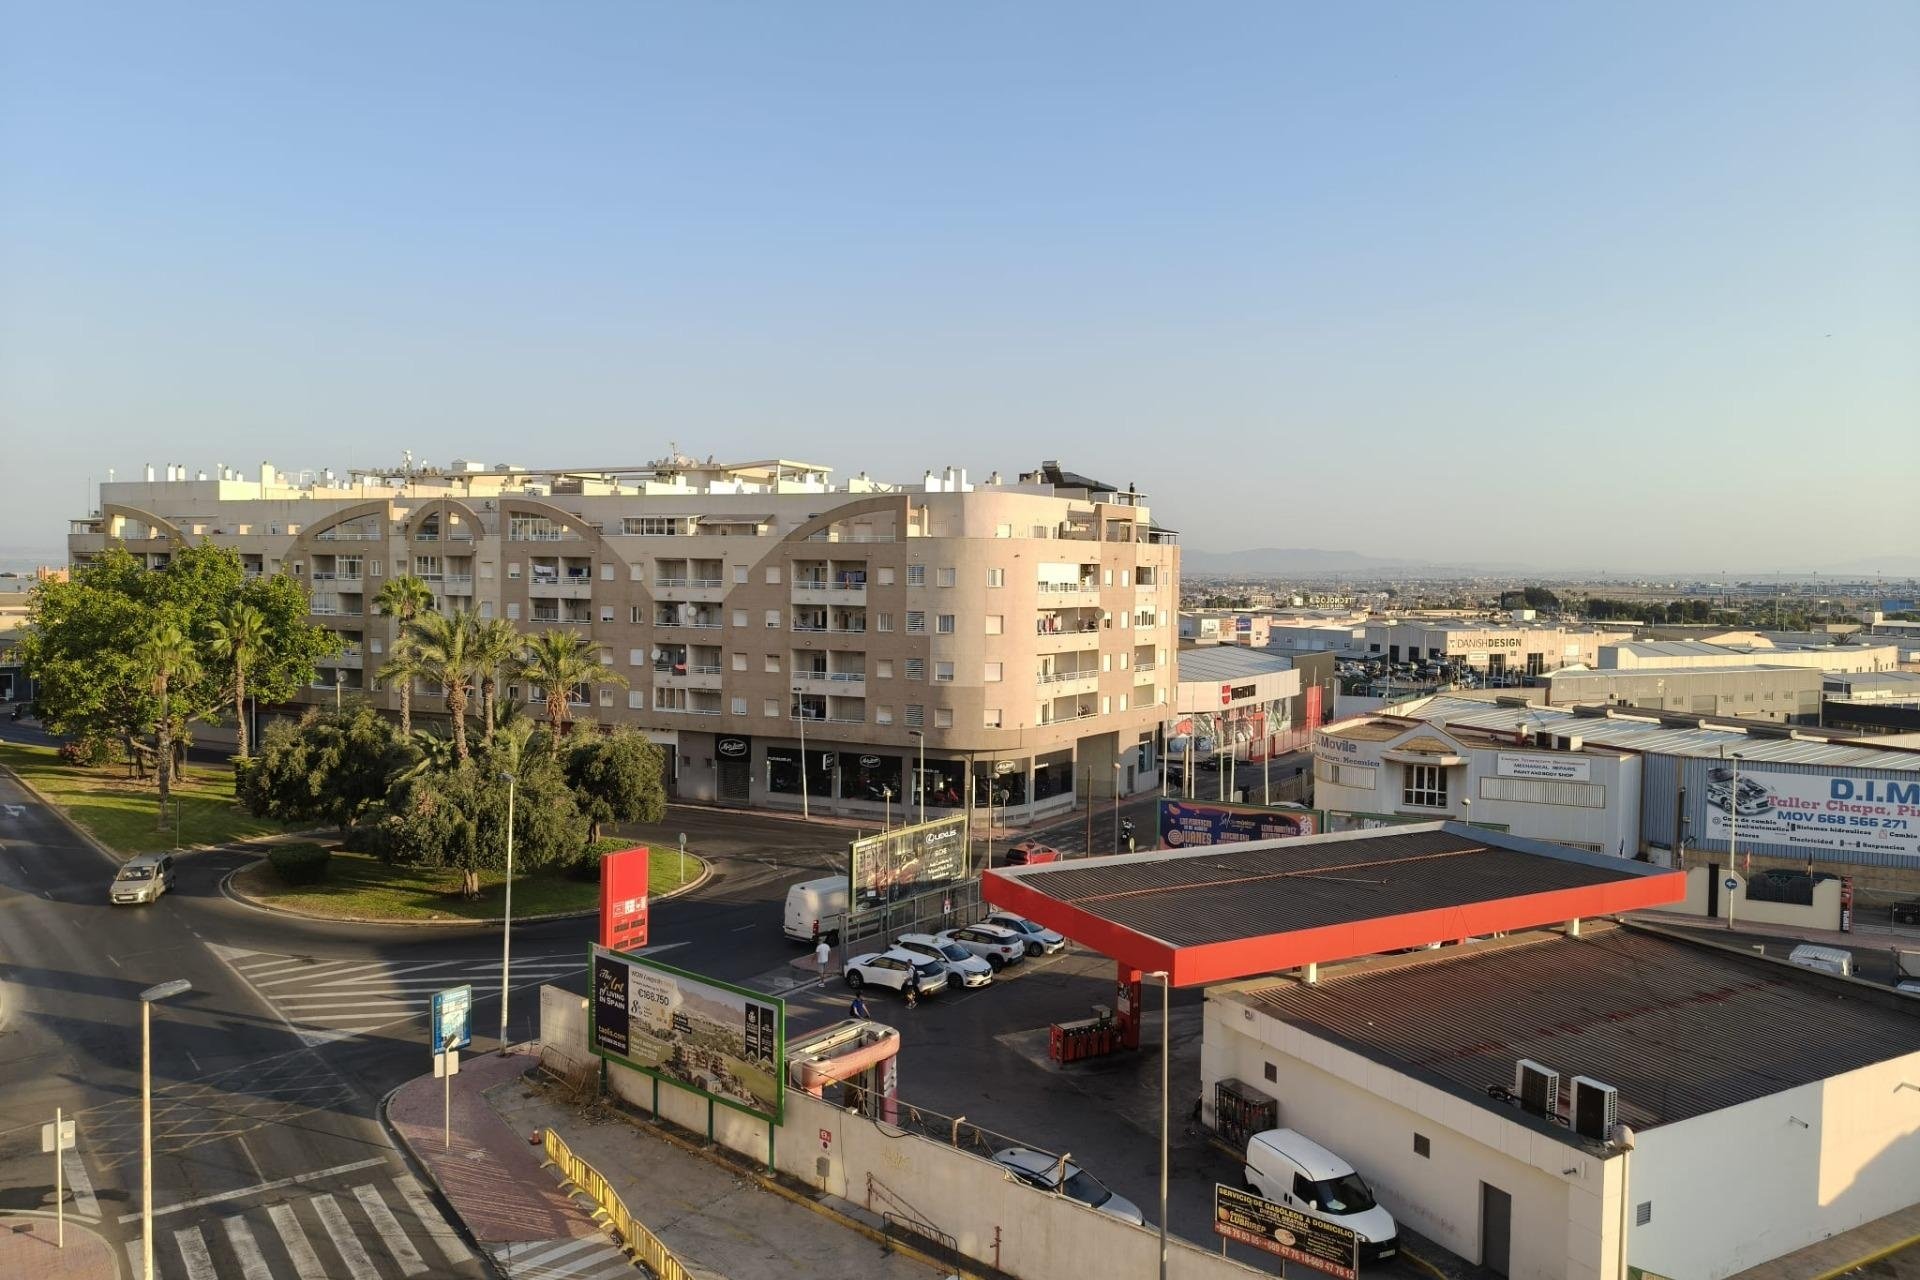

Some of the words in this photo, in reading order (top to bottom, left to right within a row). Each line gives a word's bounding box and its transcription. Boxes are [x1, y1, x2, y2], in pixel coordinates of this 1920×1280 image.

[1767, 795, 1820, 811] Taller
[1826, 799, 1891, 816] Chapa,
[1722, 815, 1739, 823] Caa
[1777, 810, 1814, 822] MOV
[1817, 813, 1846, 825] 668
[1849, 816, 1879, 827] 566
[1882, 818, 1908, 830] 271
[934, 829, 957, 840] LEXUS
[606, 997, 625, 1010] SPAIN
[1218, 1187, 1253, 1205] SERVICIO
[1253, 1199, 1264, 1208] DE
[1312, 1219, 1354, 1239] DOMICILIO
